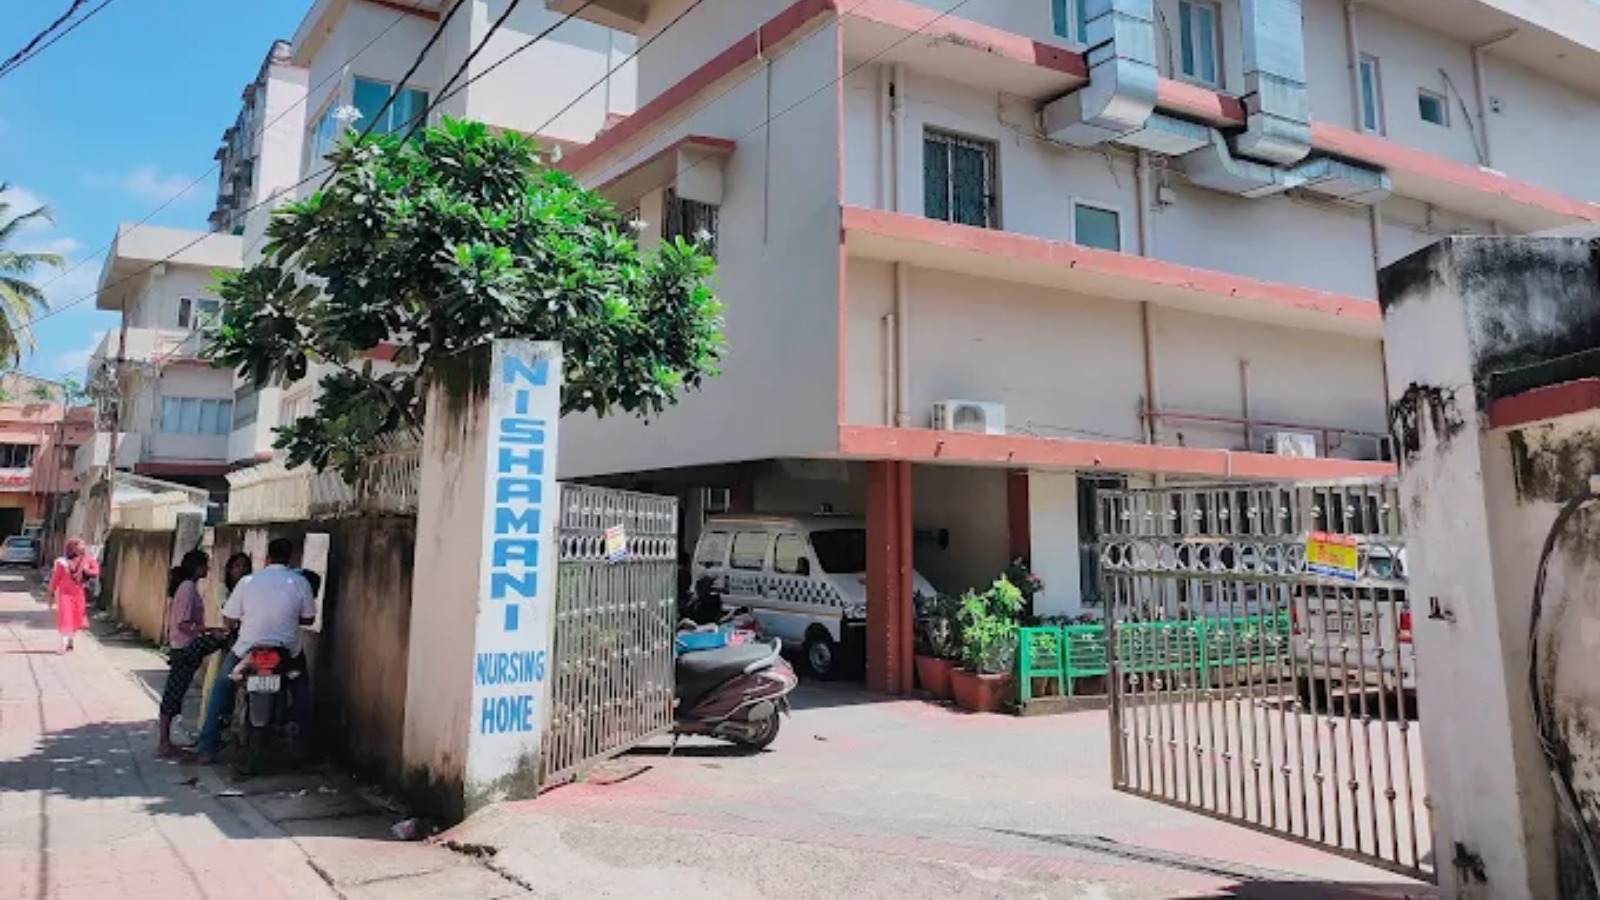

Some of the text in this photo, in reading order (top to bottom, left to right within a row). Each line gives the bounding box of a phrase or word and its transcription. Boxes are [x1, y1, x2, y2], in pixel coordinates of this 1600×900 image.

[490, 354, 549, 631] NISHAMANI
[475, 651, 545, 685] NURSING
[481, 695, 533, 734] HOME
